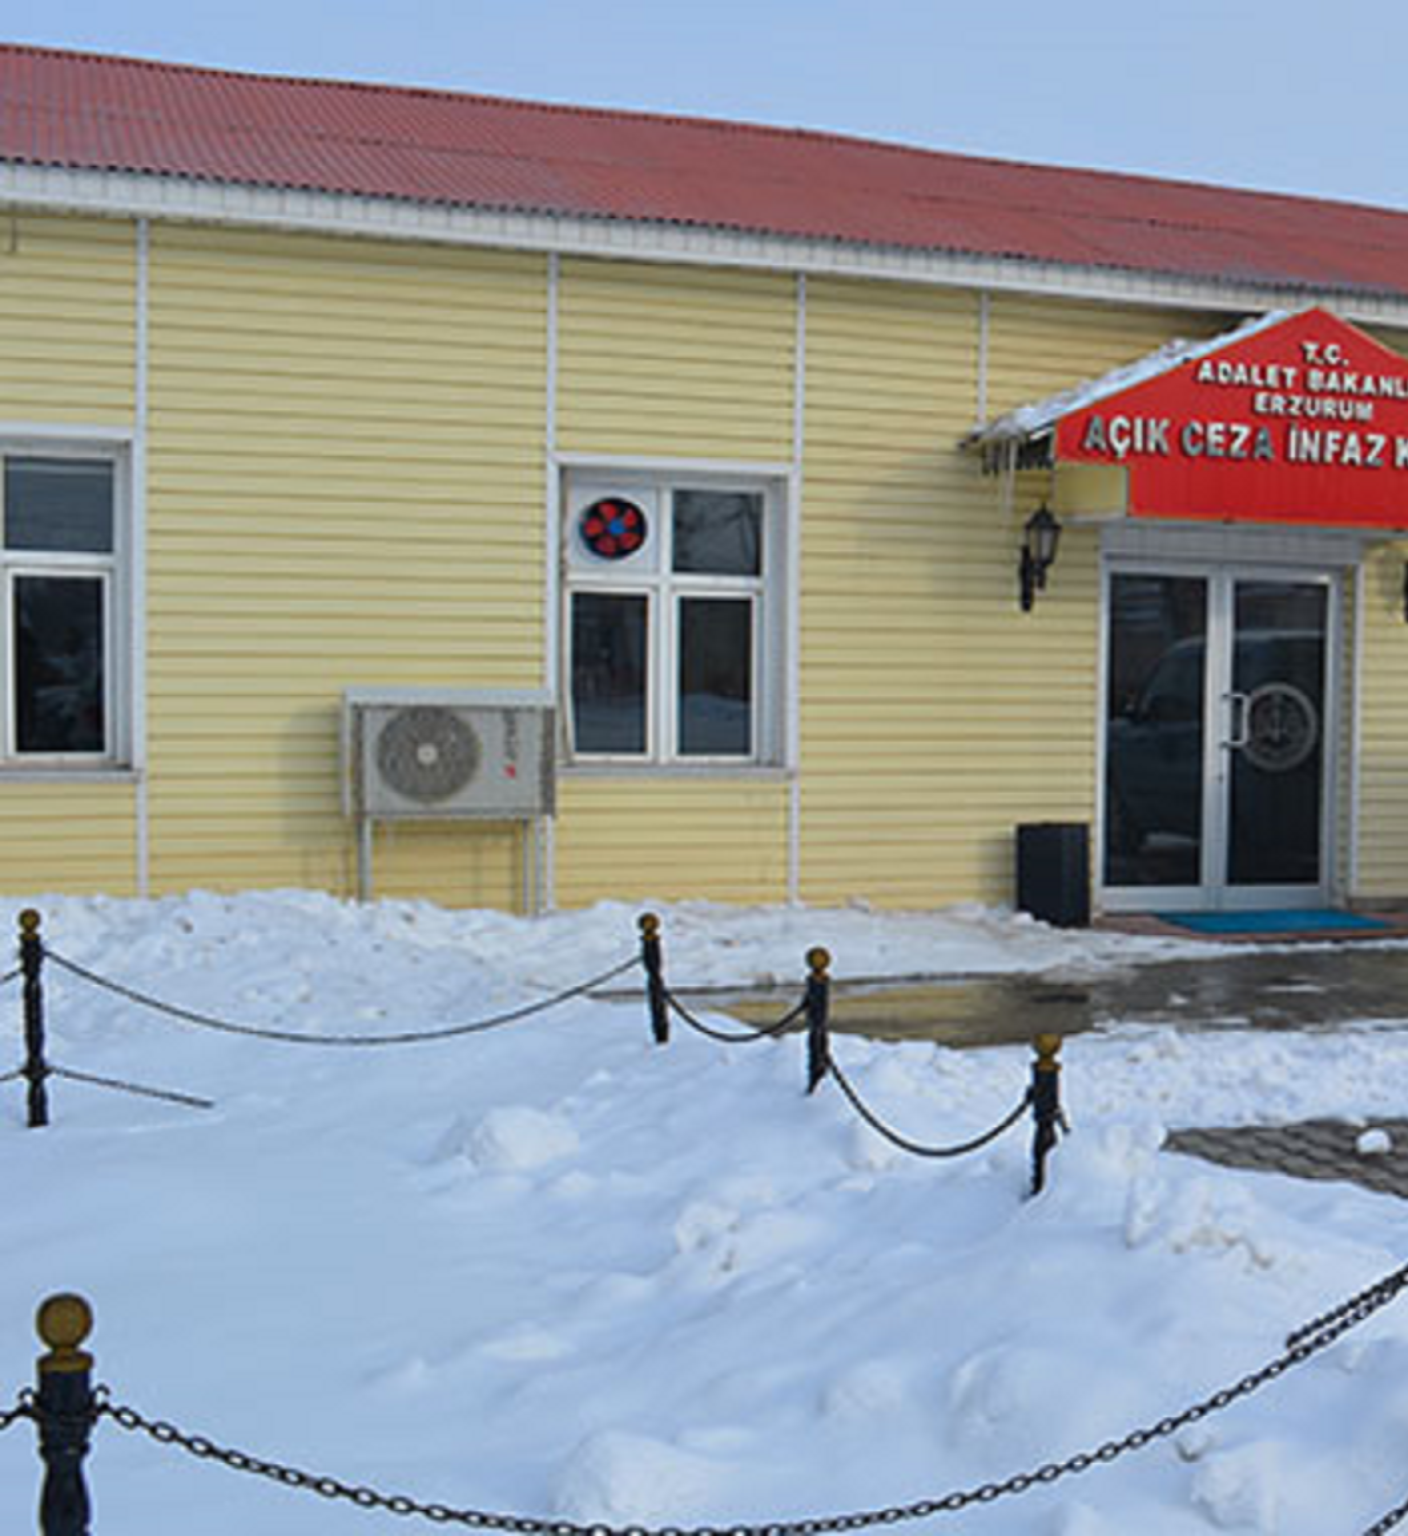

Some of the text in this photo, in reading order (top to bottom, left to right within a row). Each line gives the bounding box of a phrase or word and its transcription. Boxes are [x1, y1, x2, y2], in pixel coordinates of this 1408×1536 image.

[1302, 341, 1349, 366] T.C.
[1197, 360, 1297, 389] ADALET
[1254, 392, 1373, 421] ERZURUM
[1084, 415, 1169, 459] AÇIK
[1181, 419, 1273, 461] CEZA
[1288, 423, 1386, 467] İNFAZ
